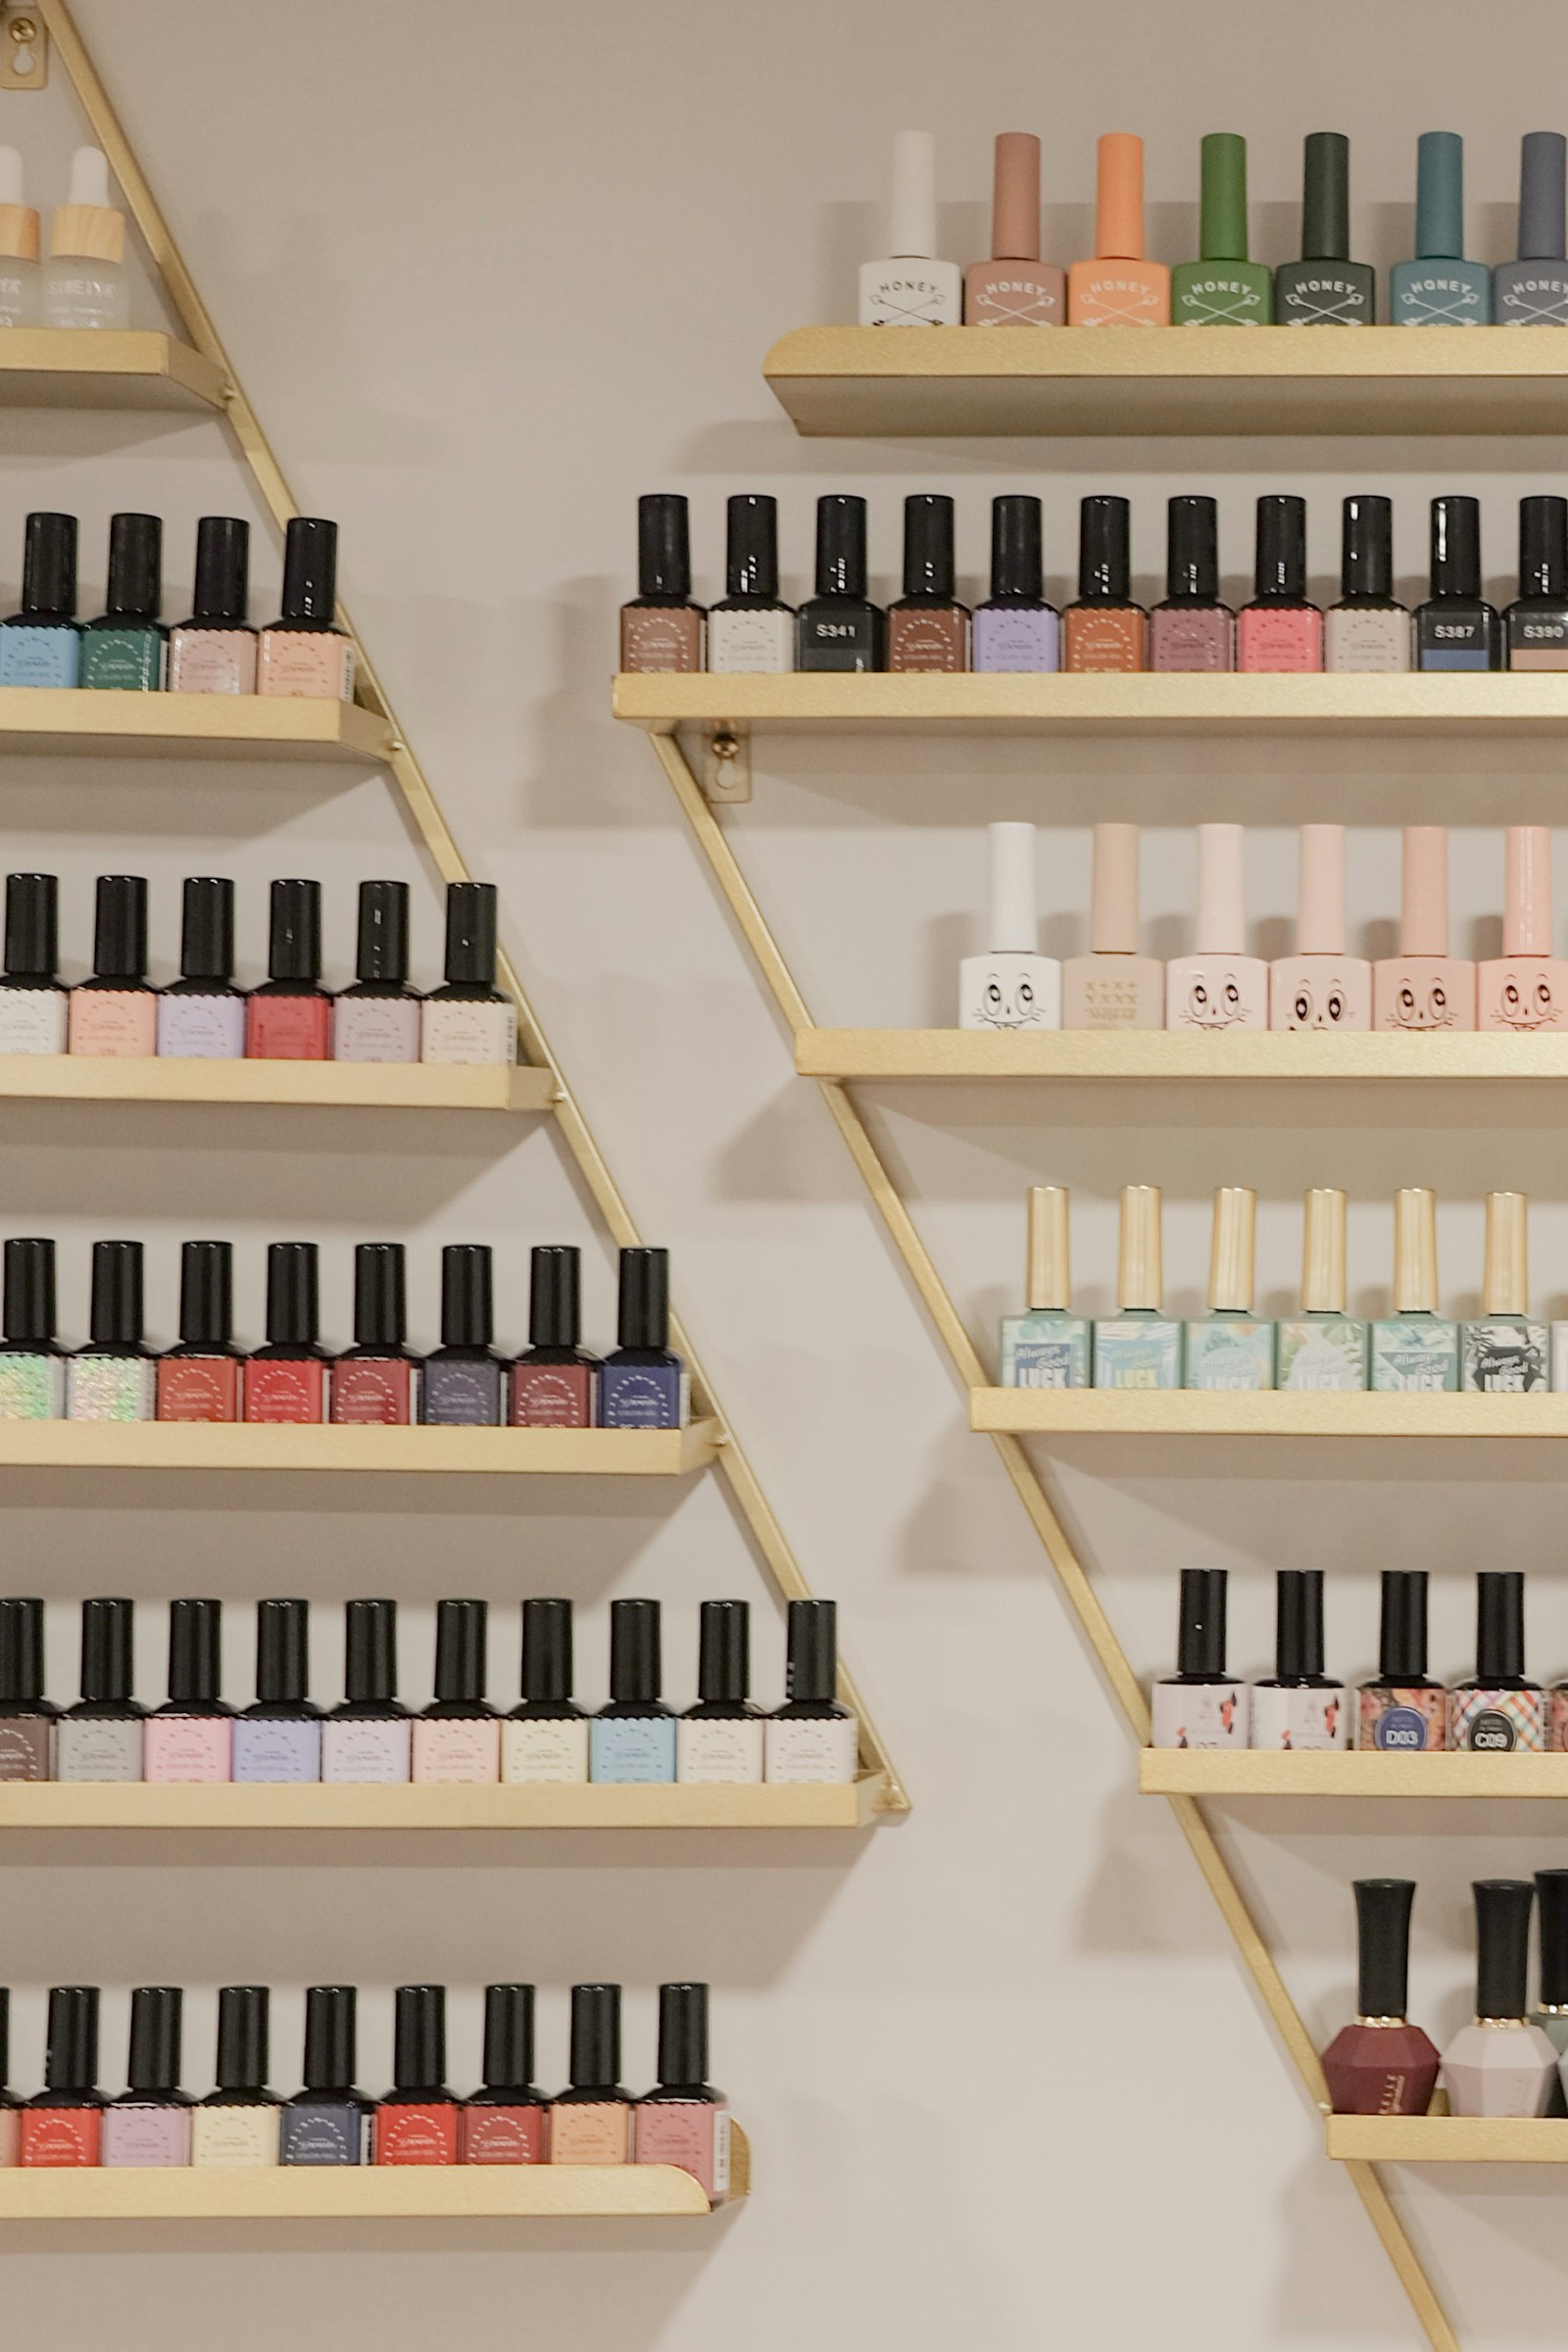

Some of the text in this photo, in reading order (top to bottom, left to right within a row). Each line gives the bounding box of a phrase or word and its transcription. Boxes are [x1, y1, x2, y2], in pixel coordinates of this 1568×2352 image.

[879, 279, 939, 295] HONEY
[986, 281, 1047, 297] HONEY
[1090, 279, 1151, 296] HONEY
[1191, 280, 1252, 296] HONEY
[1295, 279, 1356, 295] HONEY
[1411, 278, 1472, 295] HONEY
[815, 623, 857, 638] S341
[1434, 624, 1475, 639] S387
[1523, 624, 1565, 639] S390
